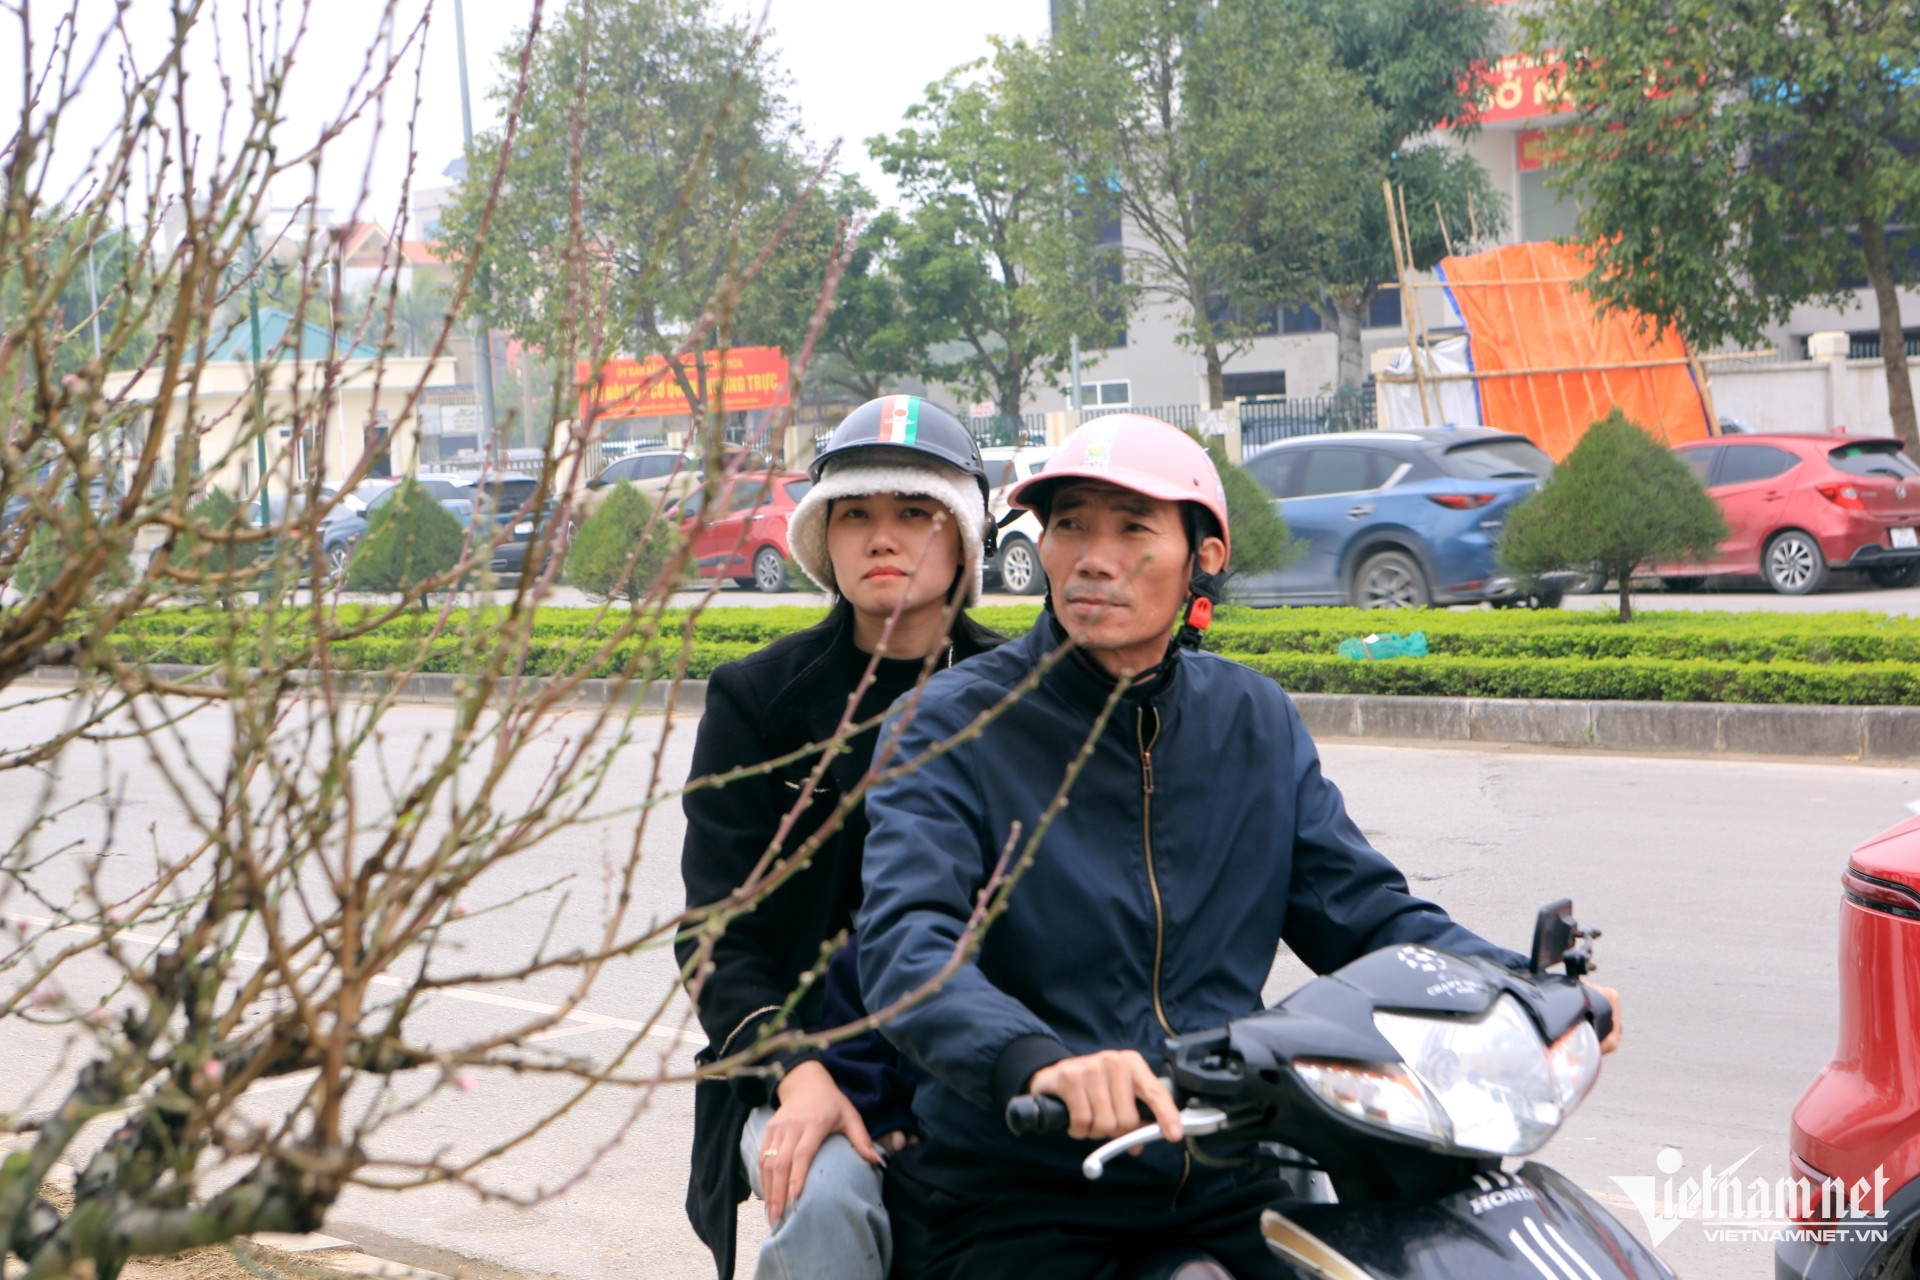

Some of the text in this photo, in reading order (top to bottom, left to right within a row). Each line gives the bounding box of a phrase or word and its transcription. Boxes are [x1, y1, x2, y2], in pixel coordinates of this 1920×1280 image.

[629, 365, 645, 378] BAN
[747, 372, 778, 395] TRỰC
[1469, 1186, 1536, 1216] HOND
